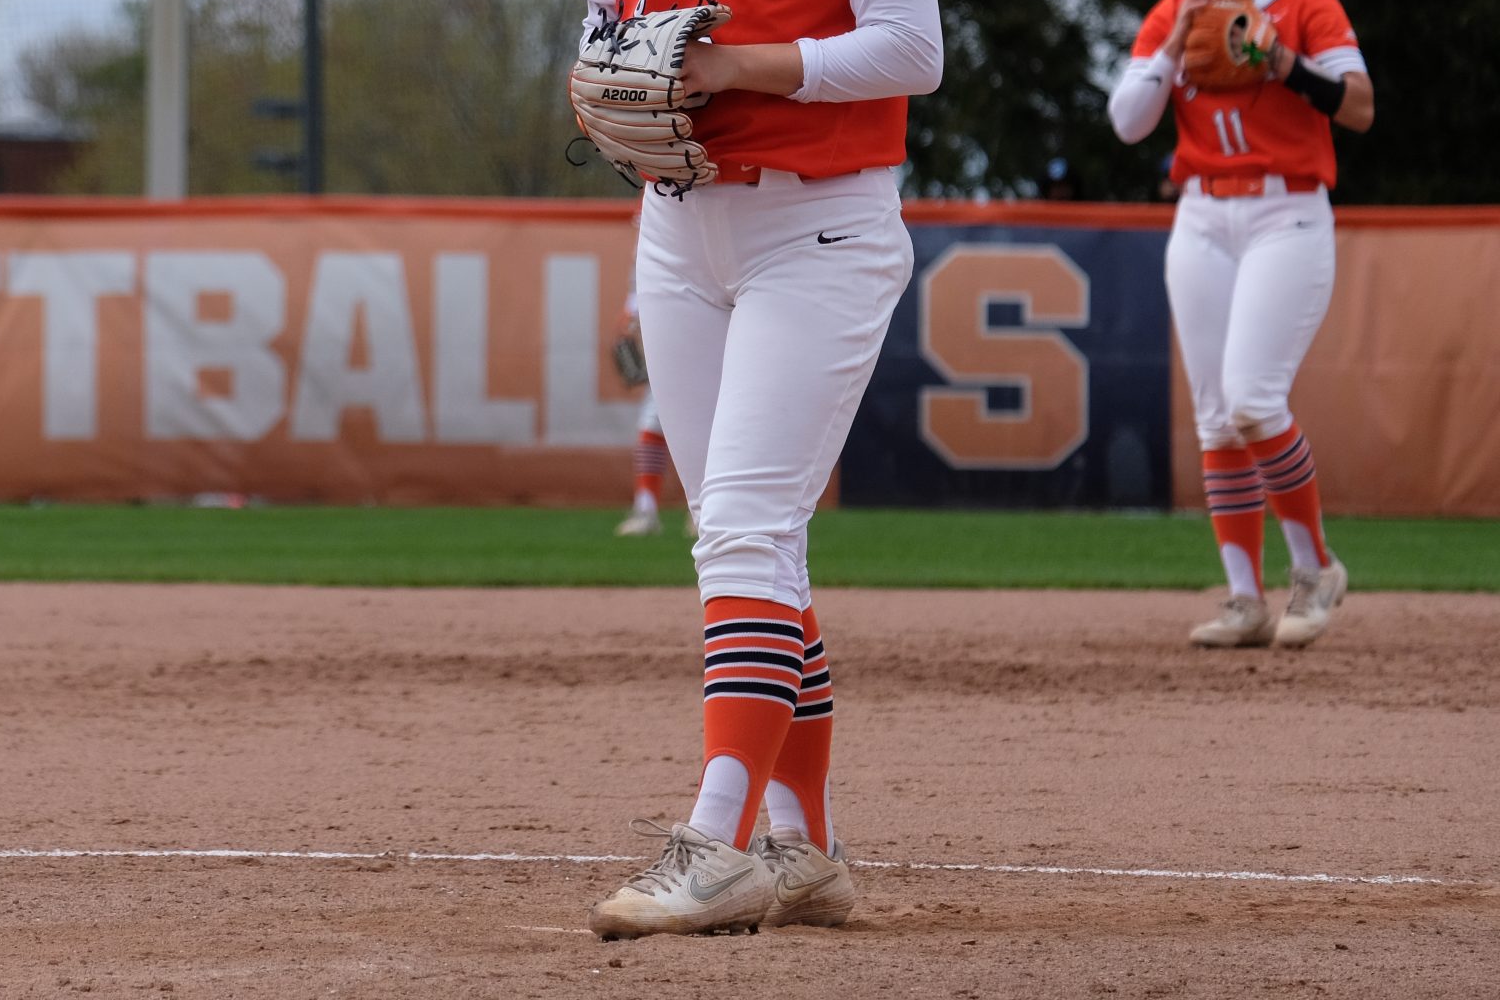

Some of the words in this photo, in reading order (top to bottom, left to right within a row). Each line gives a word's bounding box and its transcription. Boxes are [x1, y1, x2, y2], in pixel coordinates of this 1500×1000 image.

[601, 88, 648, 102] A2000
[1213, 107, 1250, 157] 11
[919, 243, 1090, 470] S
